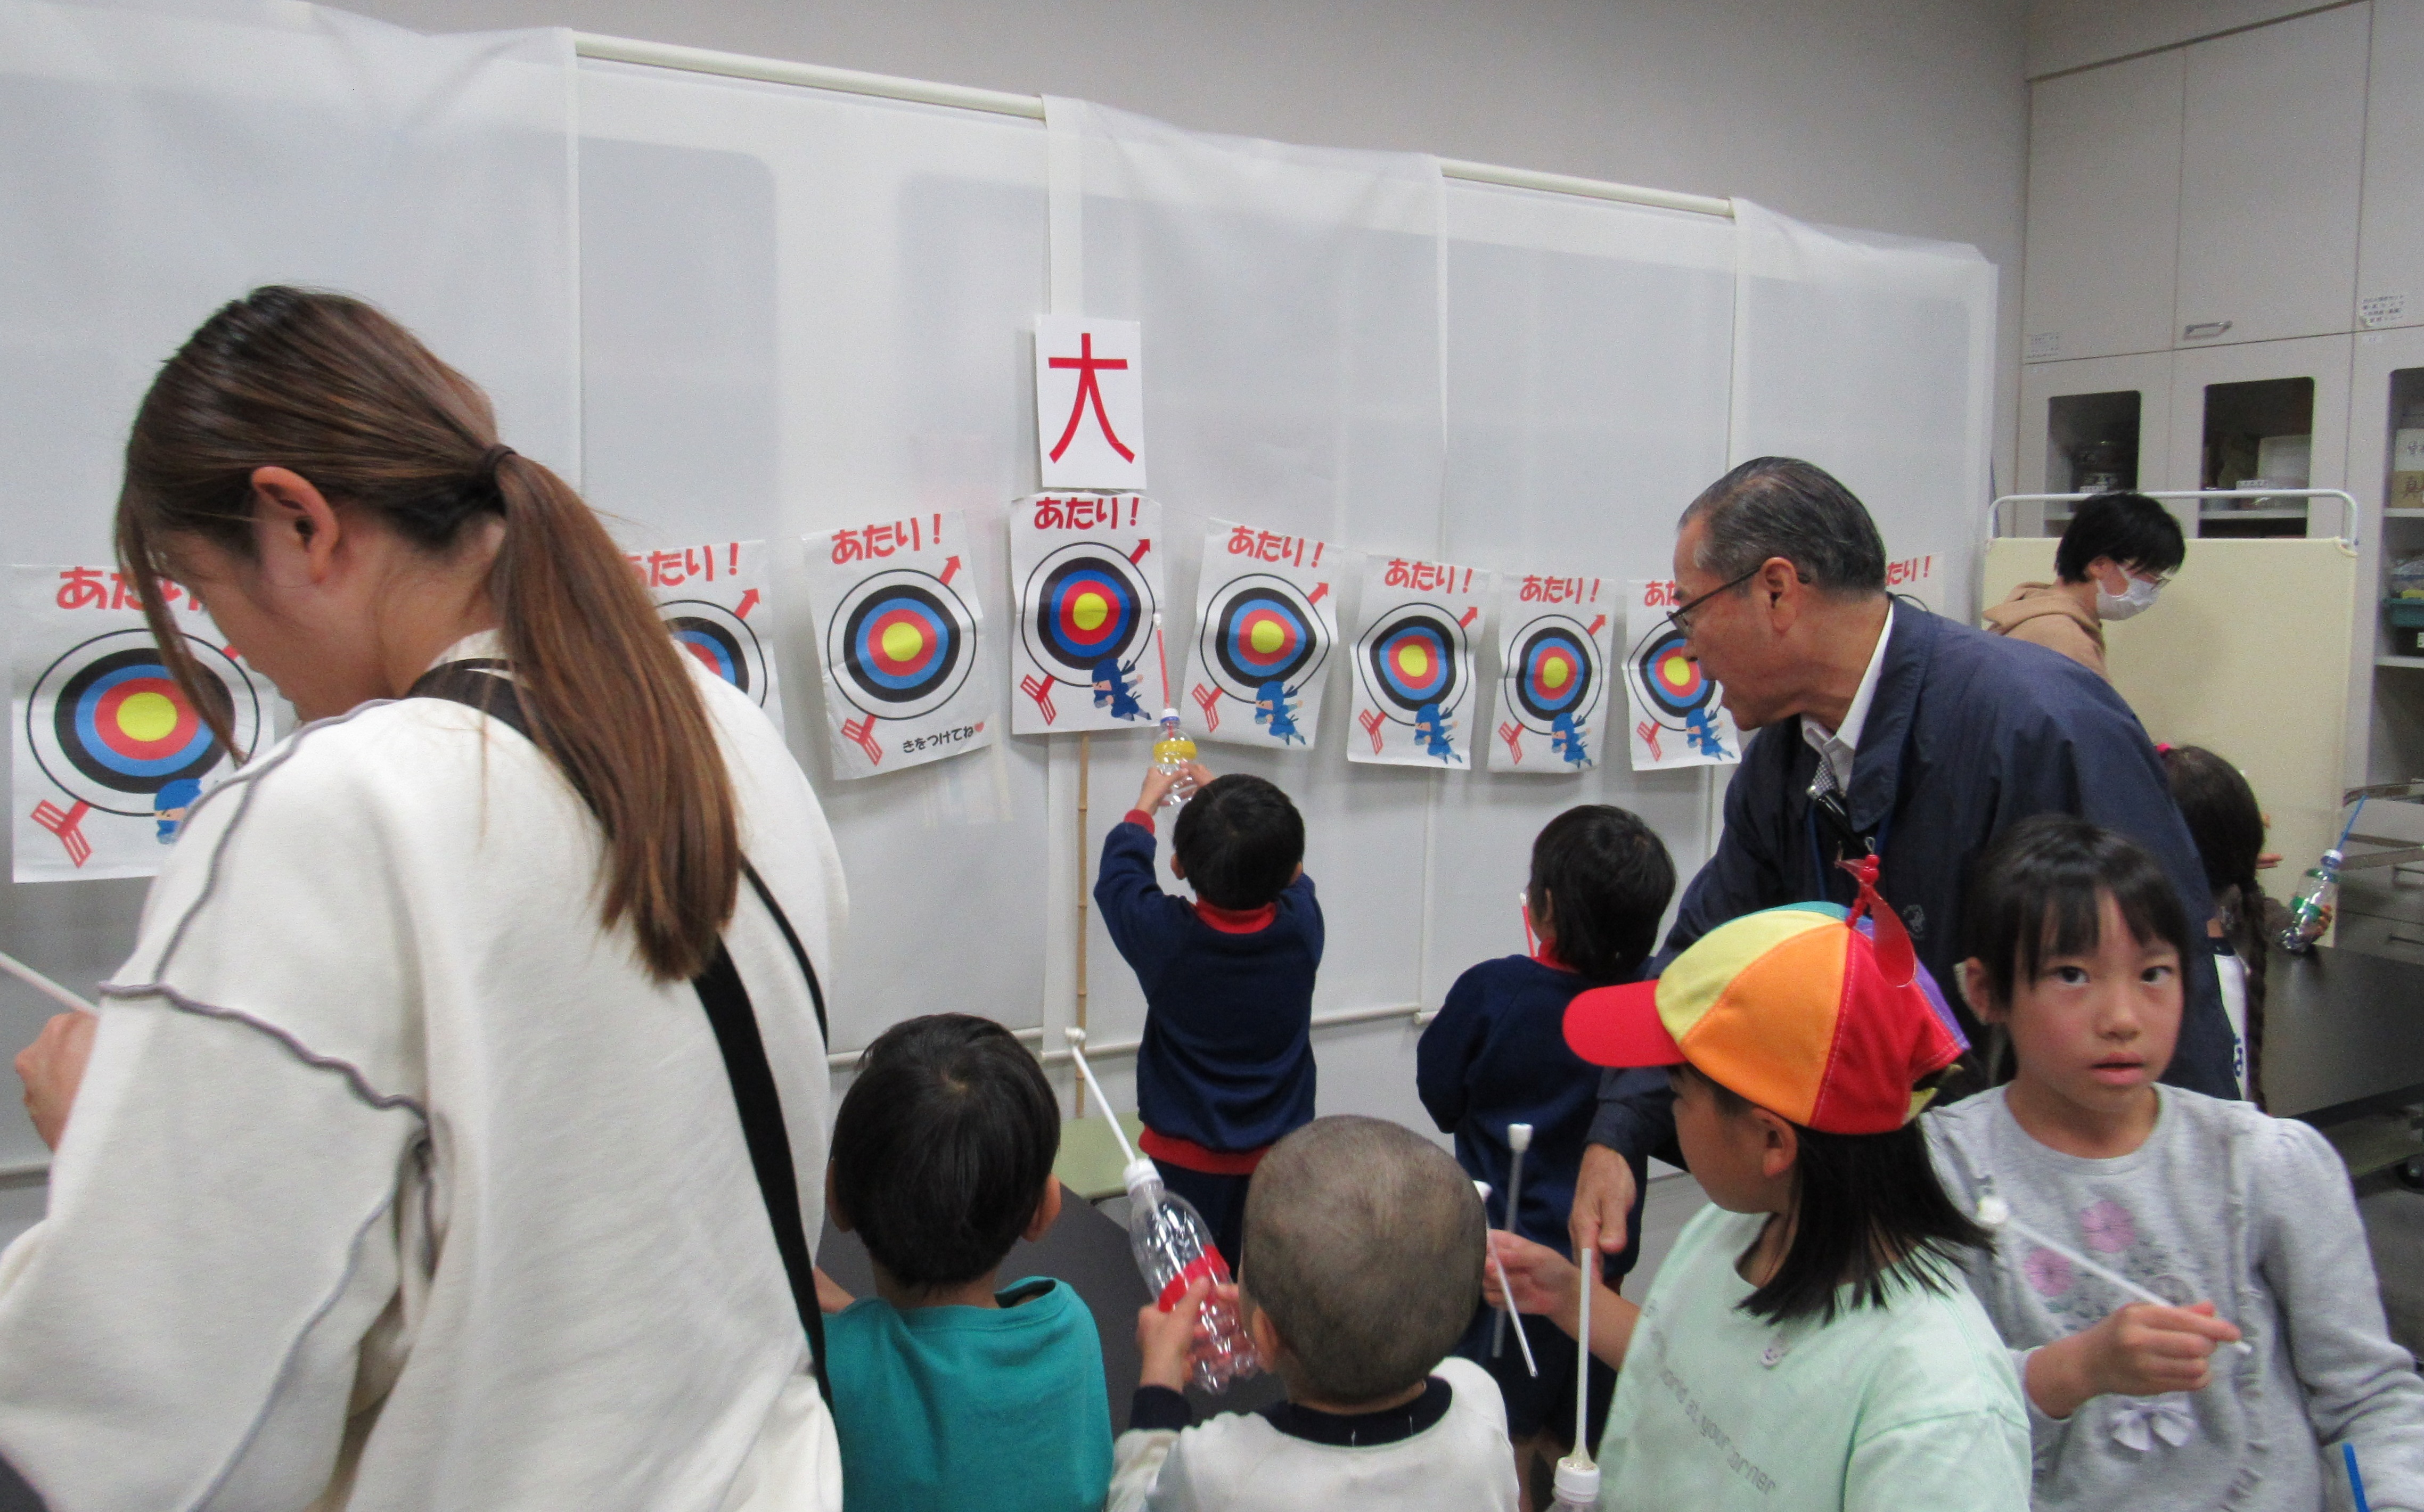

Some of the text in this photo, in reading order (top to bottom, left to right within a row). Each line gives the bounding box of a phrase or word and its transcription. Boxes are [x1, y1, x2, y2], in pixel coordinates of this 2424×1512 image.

[1049, 333, 1135, 464] 大
[1034, 497, 1139, 530] あたり！
[832, 513, 941, 564] あたり！
[1228, 526, 1324, 568] あたり！
[1385, 558, 1472, 594] あたり！
[1520, 575, 1600, 604] あたり！
[903, 726, 974, 753] きをつけてね
